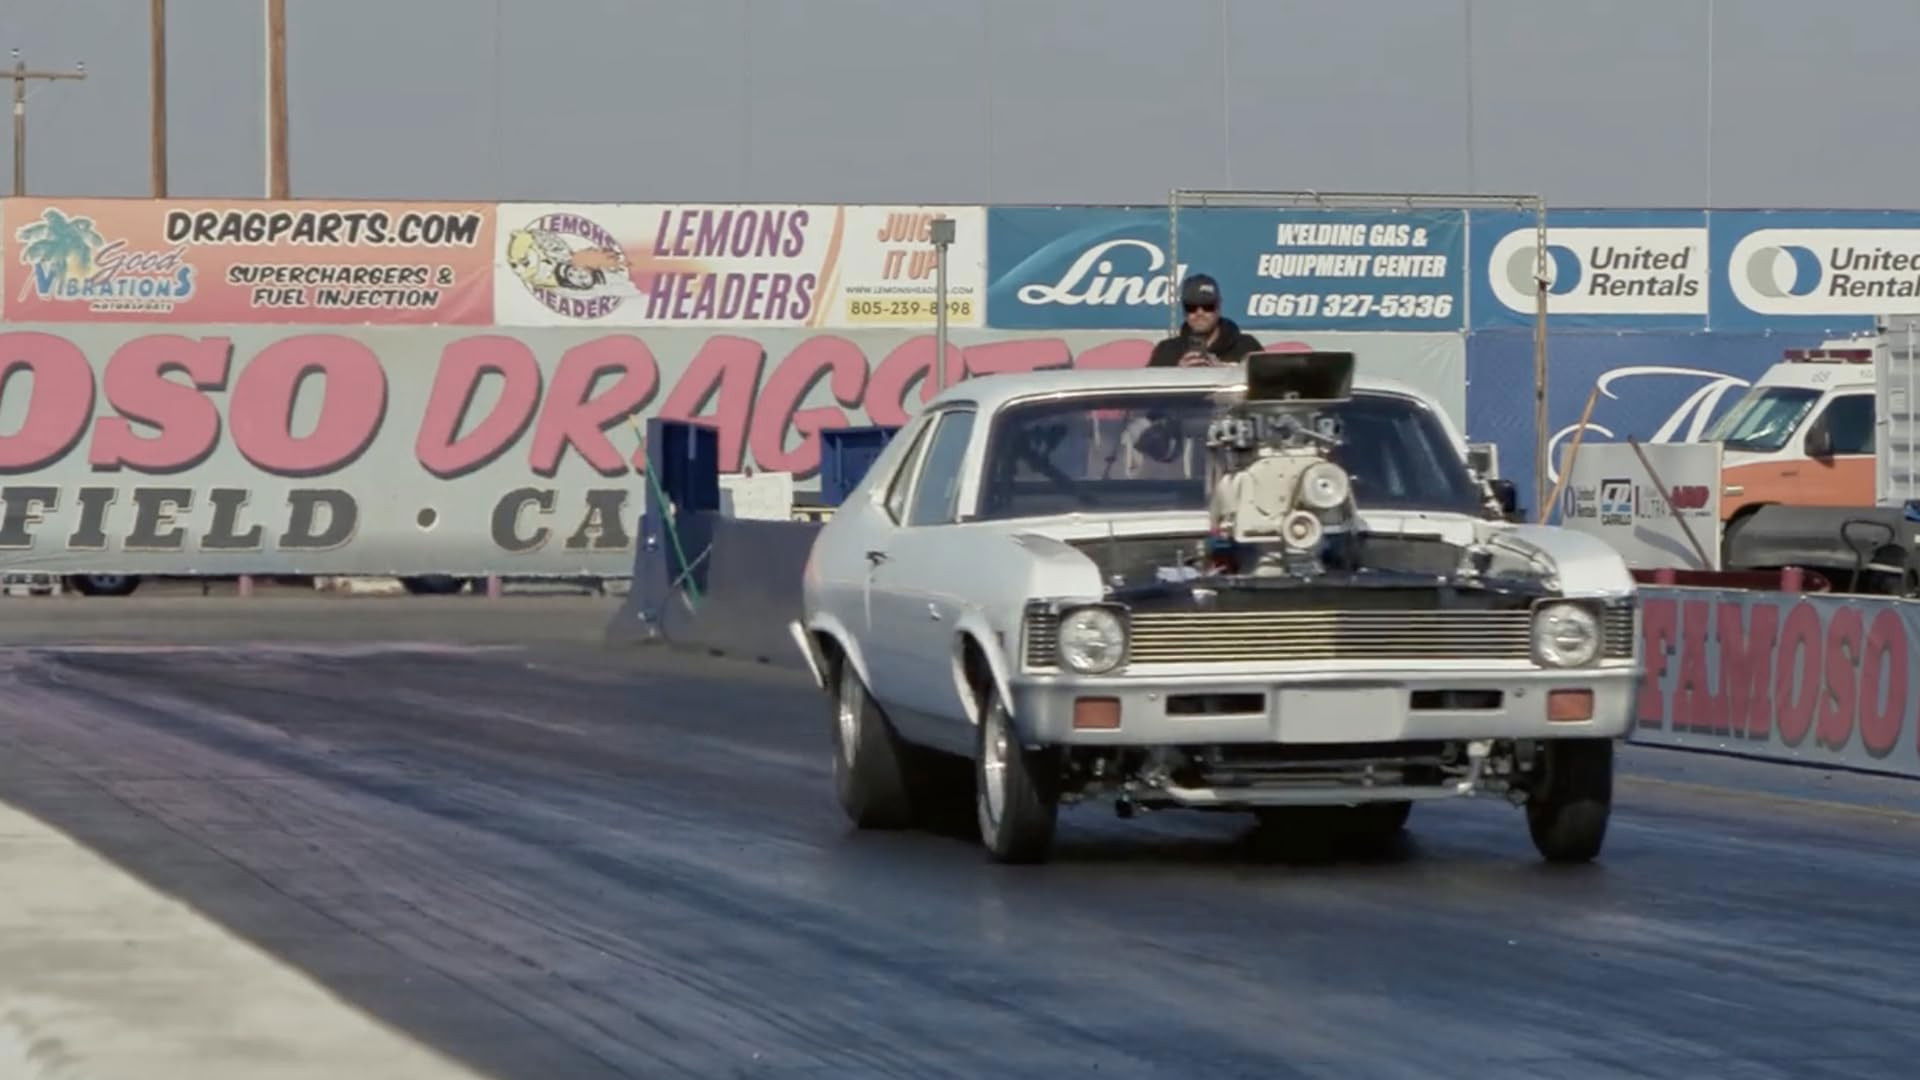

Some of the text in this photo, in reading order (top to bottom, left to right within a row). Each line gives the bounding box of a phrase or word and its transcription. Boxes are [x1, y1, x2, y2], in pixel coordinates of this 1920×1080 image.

[166, 211, 481, 244] DRAGPARTS.COM
[652, 209, 810, 258] LEMONS
[878, 213, 947, 243] JUIC
[1277, 223, 1429, 247] WELDING GAS &
[93, 241, 187, 284] Good
[881, 250, 939, 280] IT UP
[1257, 254, 1448, 279] EQUIPMENT CENTER
[1590, 245, 1691, 270] United
[34, 262, 192, 297] VIBRATIONS
[229, 266, 453, 285] SUPERCHARGERS &
[1017, 238, 1188, 306] Lind
[1588, 272, 1700, 297] Rentals
[253, 289, 439, 307] FUEL INJECTION
[645, 272, 817, 321] HEADERS
[845, 286, 974, 295] WWW.LEMONSHEAD.COM
[850, 301, 971, 316] 805-239-898
[1248, 293, 1453, 318] (661) 327-5336
[1638, 600, 1909, 760] FAMOSO
